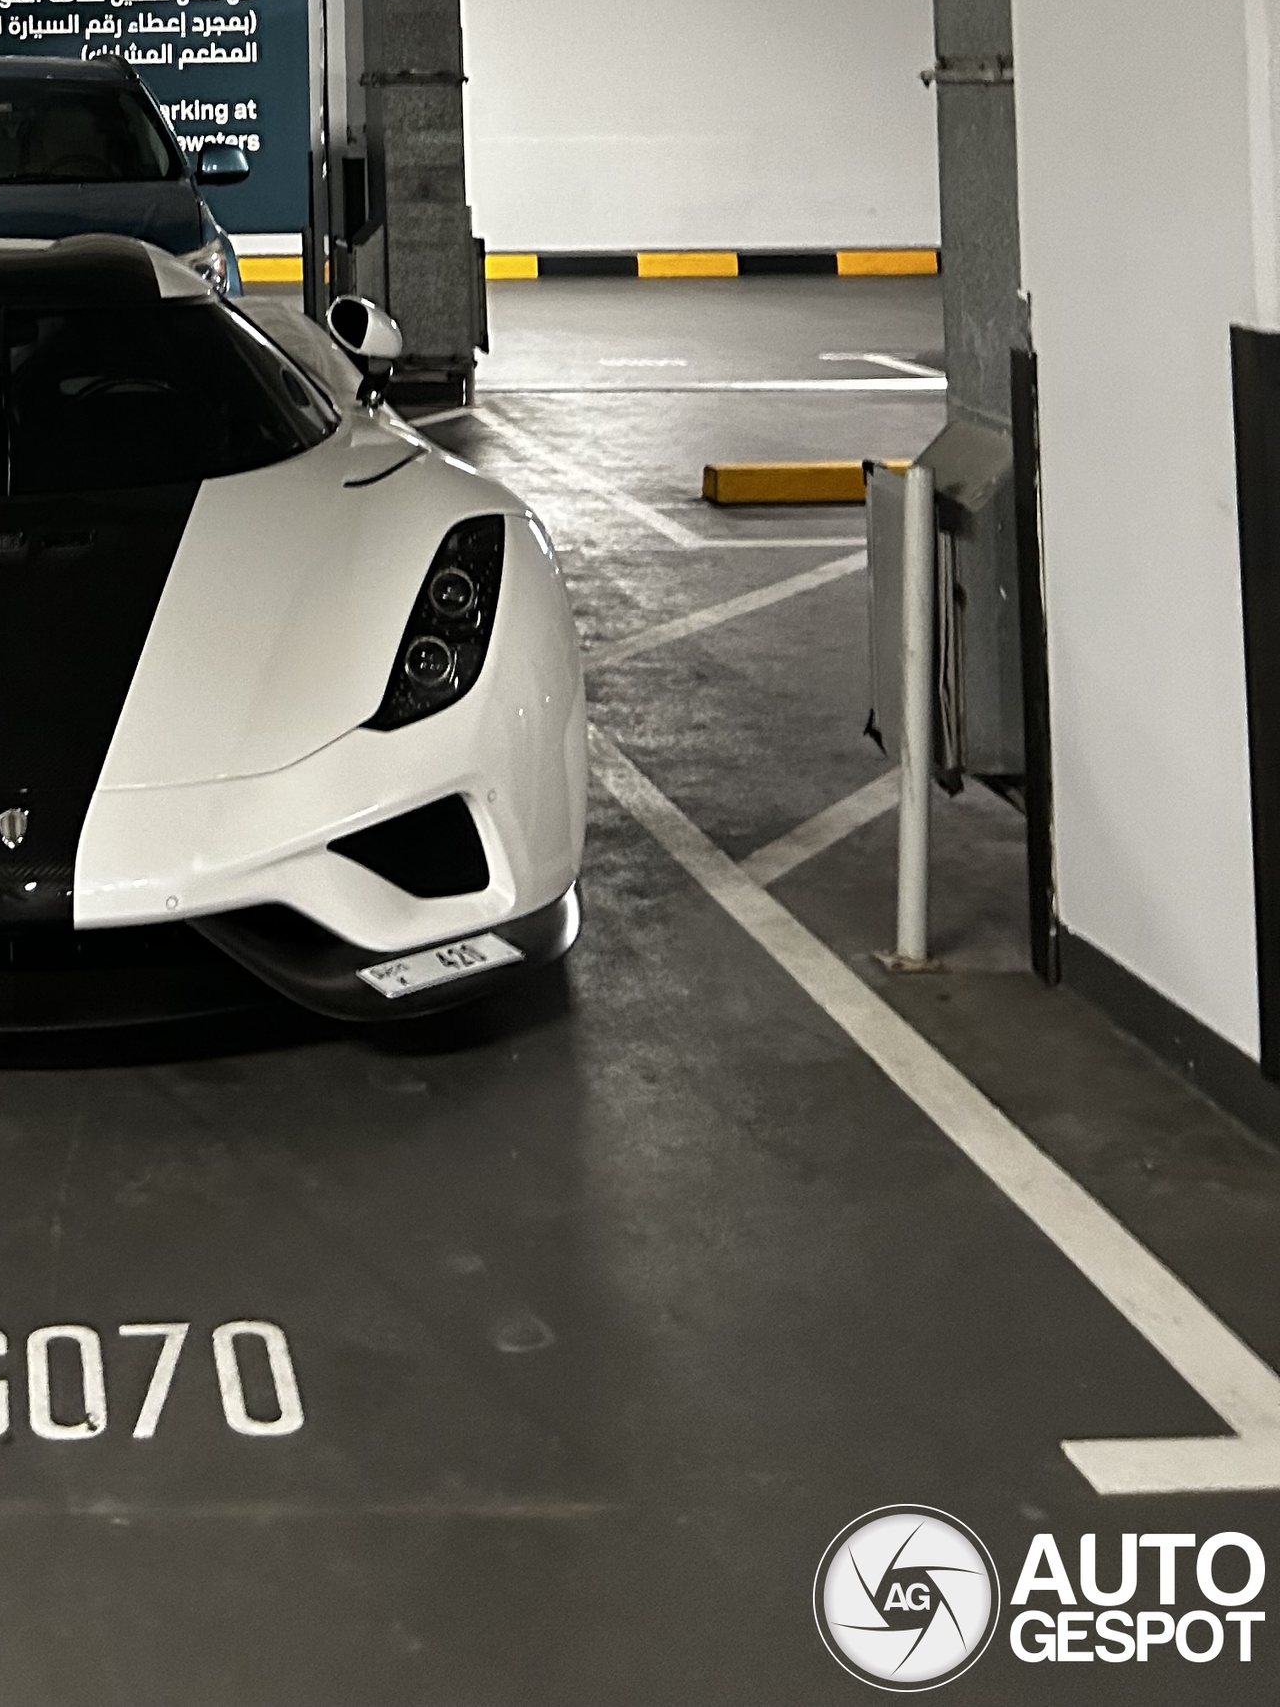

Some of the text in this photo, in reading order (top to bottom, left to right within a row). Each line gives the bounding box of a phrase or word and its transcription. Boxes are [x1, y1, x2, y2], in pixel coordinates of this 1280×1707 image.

[8, 14, 80, 39] السيارة
[84, 14, 122, 40] رقم
[127, 12, 187, 38] إعطاء
[191, 10, 257, 37] (بمجرد
[178, 42, 258, 70] المطعم
[234, 99, 258, 120] at
